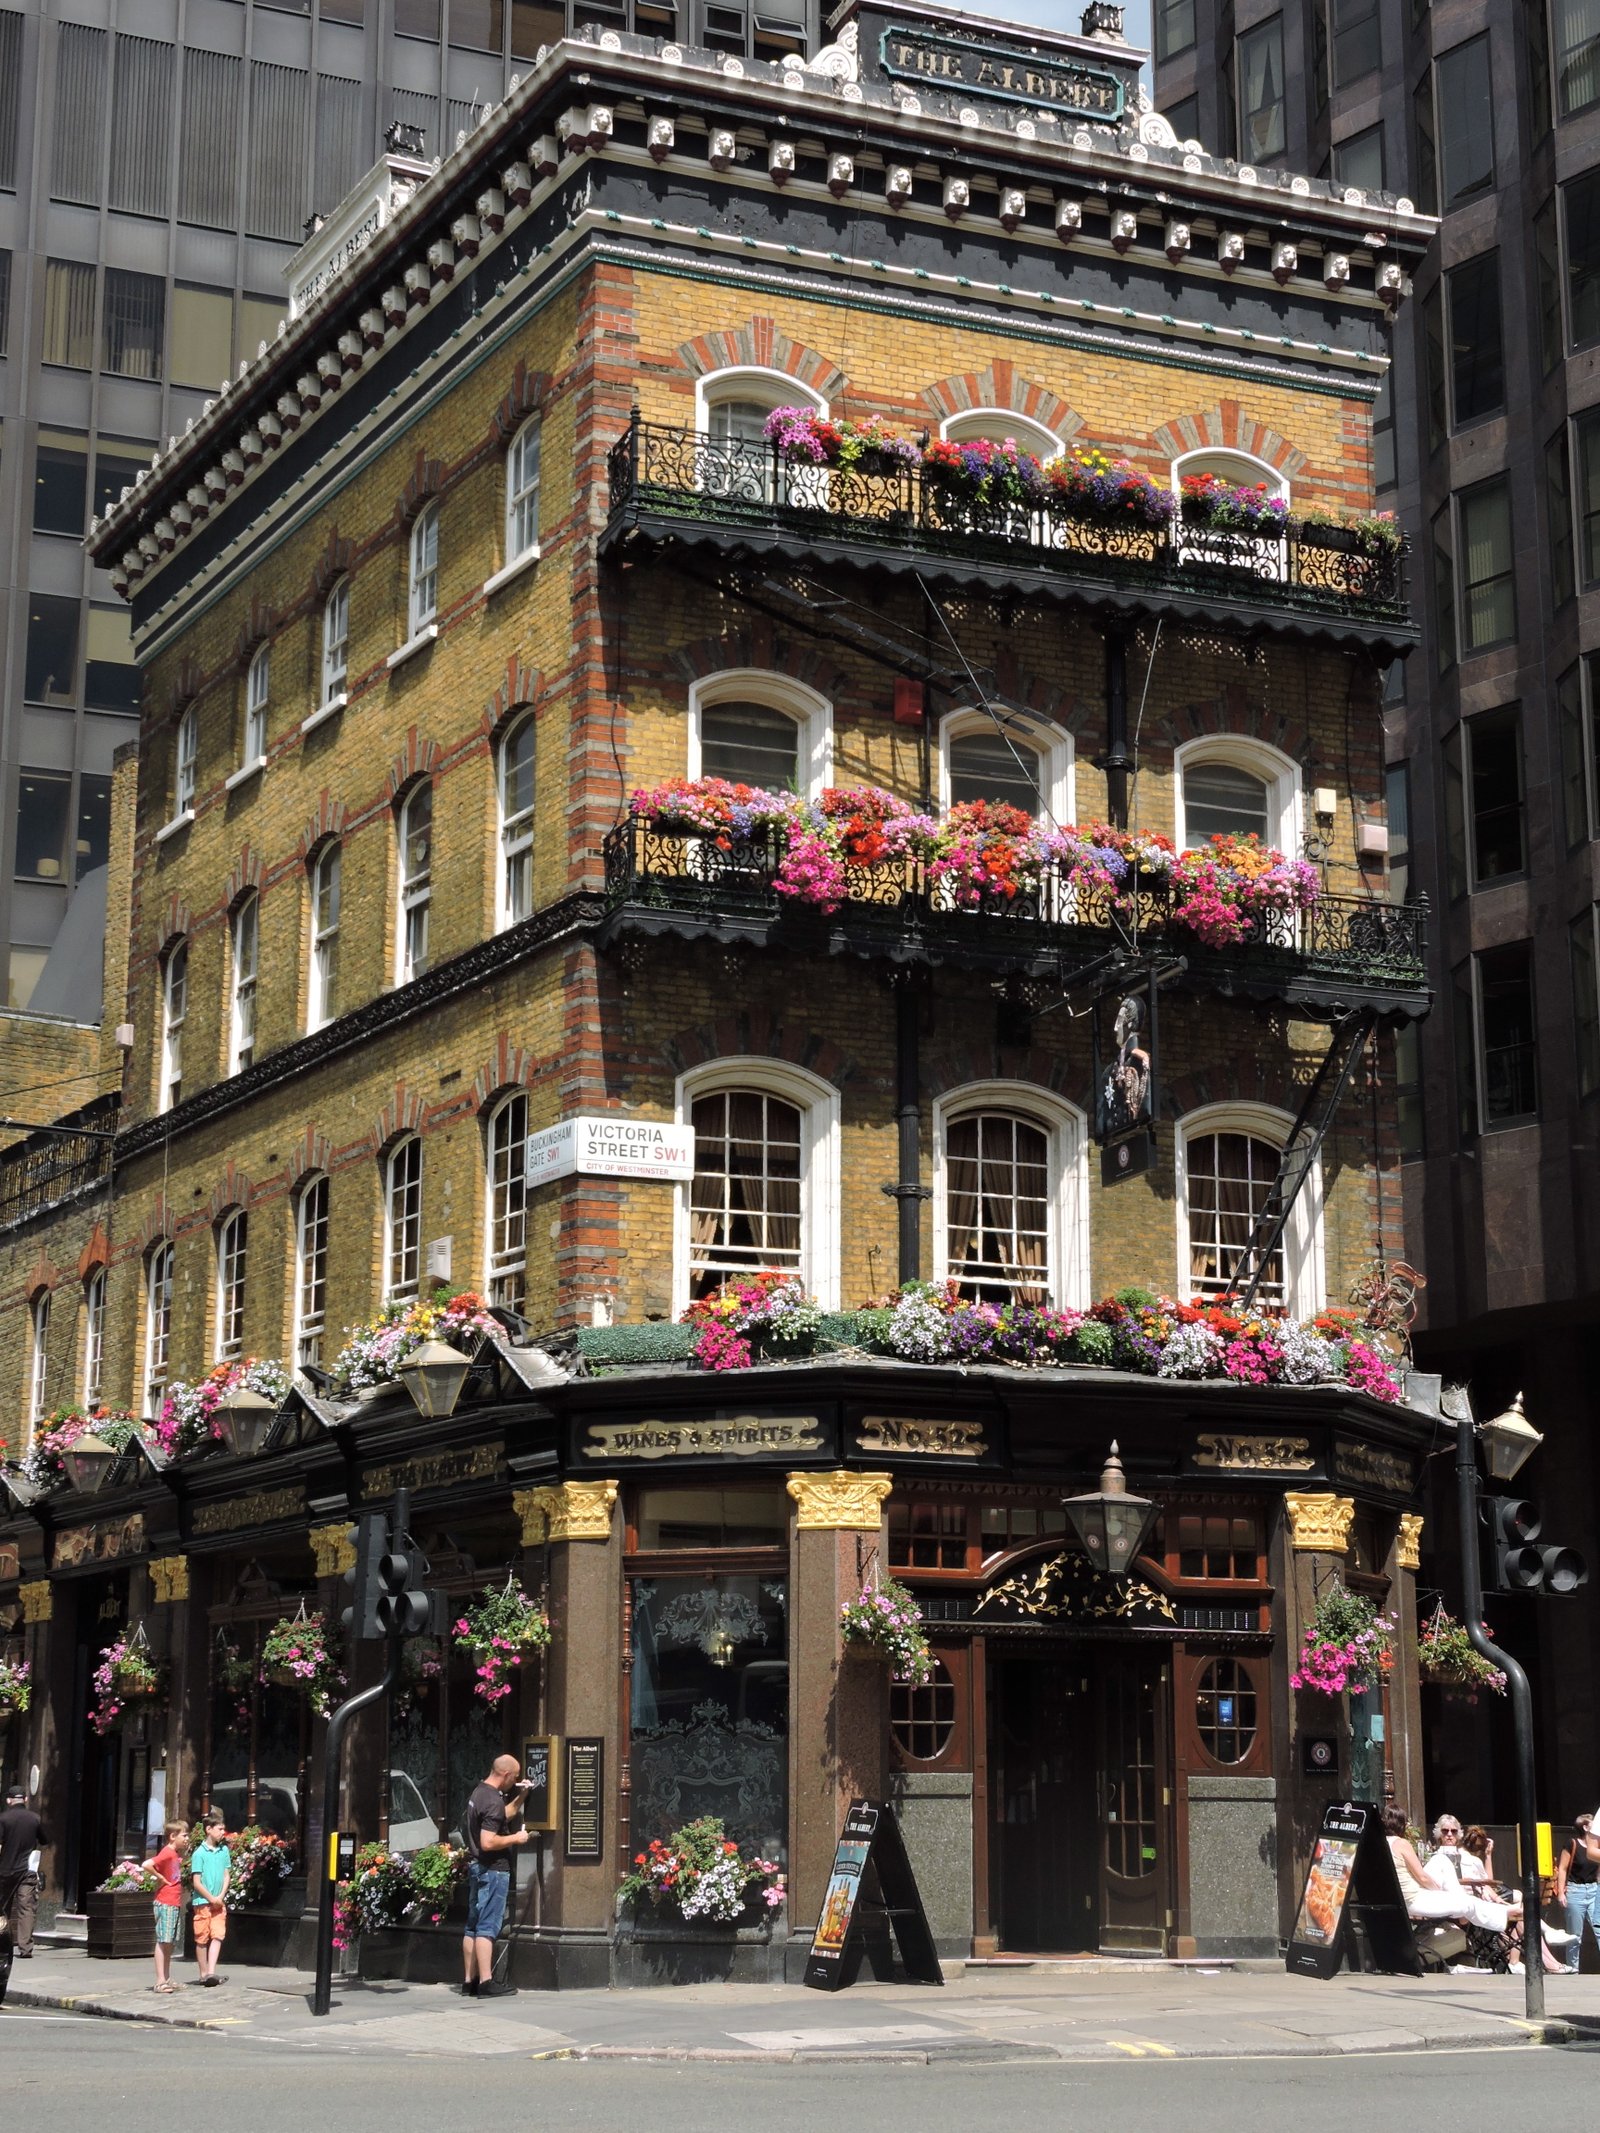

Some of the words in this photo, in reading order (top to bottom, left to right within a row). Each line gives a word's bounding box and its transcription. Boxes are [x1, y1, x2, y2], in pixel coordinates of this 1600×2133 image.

[893, 44, 962, 77] THE
[977, 60, 1113, 107] ALBERT
[297, 272, 323, 300] THE
[329, 211, 380, 277] ALBERT
[530, 1124, 572, 1153] BUCKINGHAM
[588, 1123, 664, 1143] VICTORIA
[530, 1151, 545, 1169] GATE
[547, 1146, 560, 1163] SW1
[587, 1141, 649, 1159] STREET
[654, 1146, 687, 1162] SW1
[586, 1161, 603, 1170] CITY
[604, 1163, 615, 1171] OF
[616, 1165, 669, 1176] WESTMINSTER
[613, 1430, 681, 1450] WINES
[690, 1430, 702, 1448] &
[710, 1425, 794, 1445] SPIRITS
[527, 1760, 547, 1778] CRAFT
[1340, 1822, 1358, 1831] ALBERT
